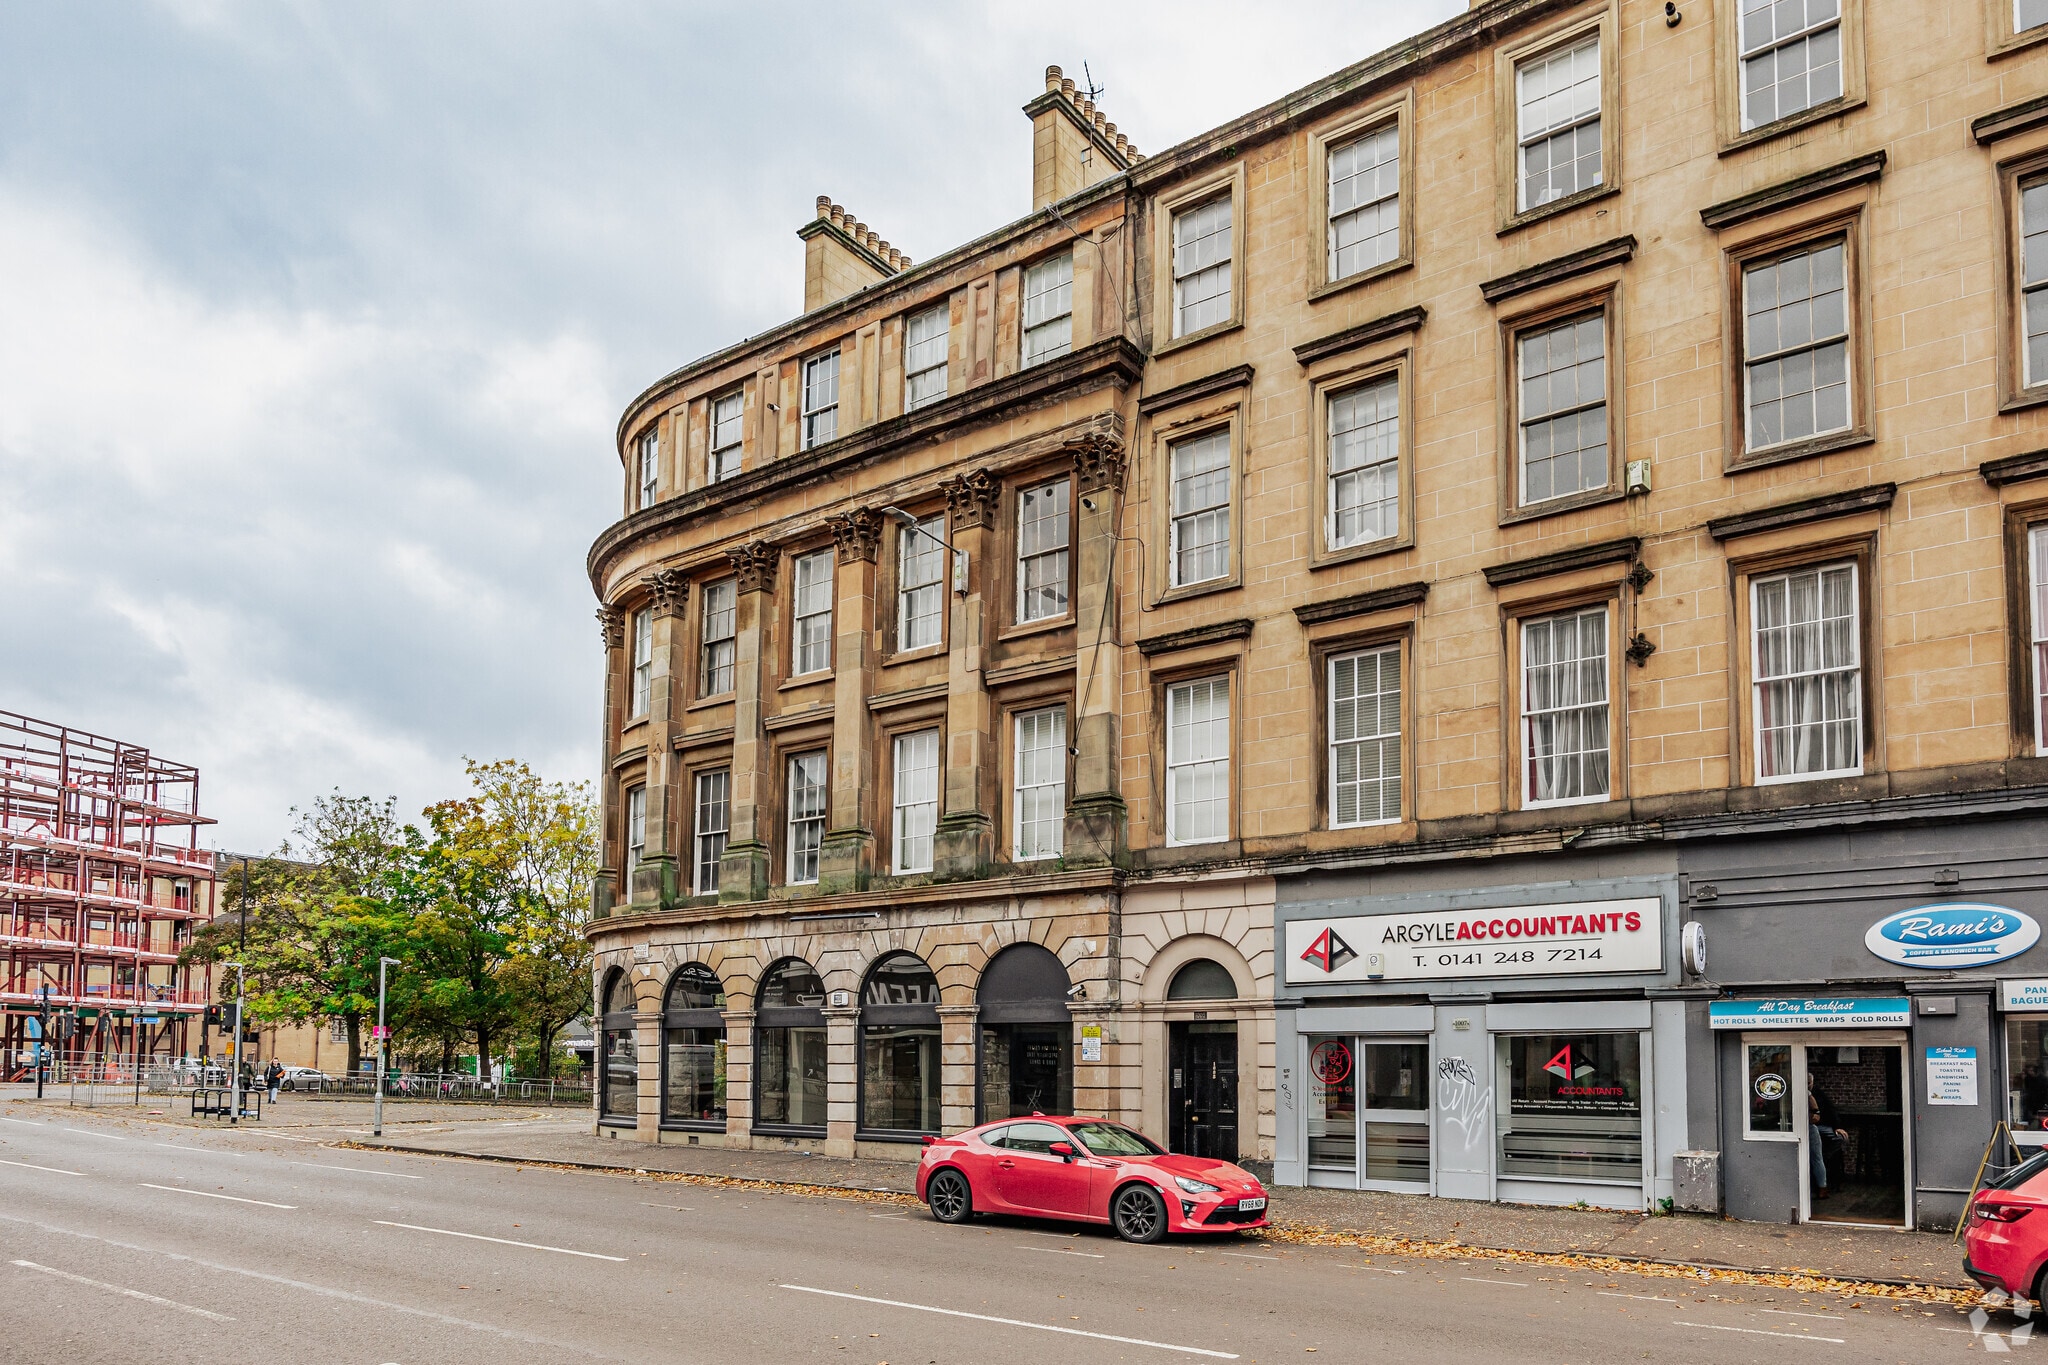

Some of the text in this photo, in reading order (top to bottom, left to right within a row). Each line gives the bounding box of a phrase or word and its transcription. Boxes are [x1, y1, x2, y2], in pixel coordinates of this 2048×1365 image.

[1381, 911, 1641, 943] ARGYLE ACCOUNTANTS
[1898, 914, 2007, 940] Rami's
[1412, 948, 1603, 967] T. 0141 248 7214
[1941, 947, 1977, 955] SANDWICH
[1757, 1000, 1854, 1013] All Day Breakfast
[1557, 1087, 1623, 1096] ACCOUNTANTS
